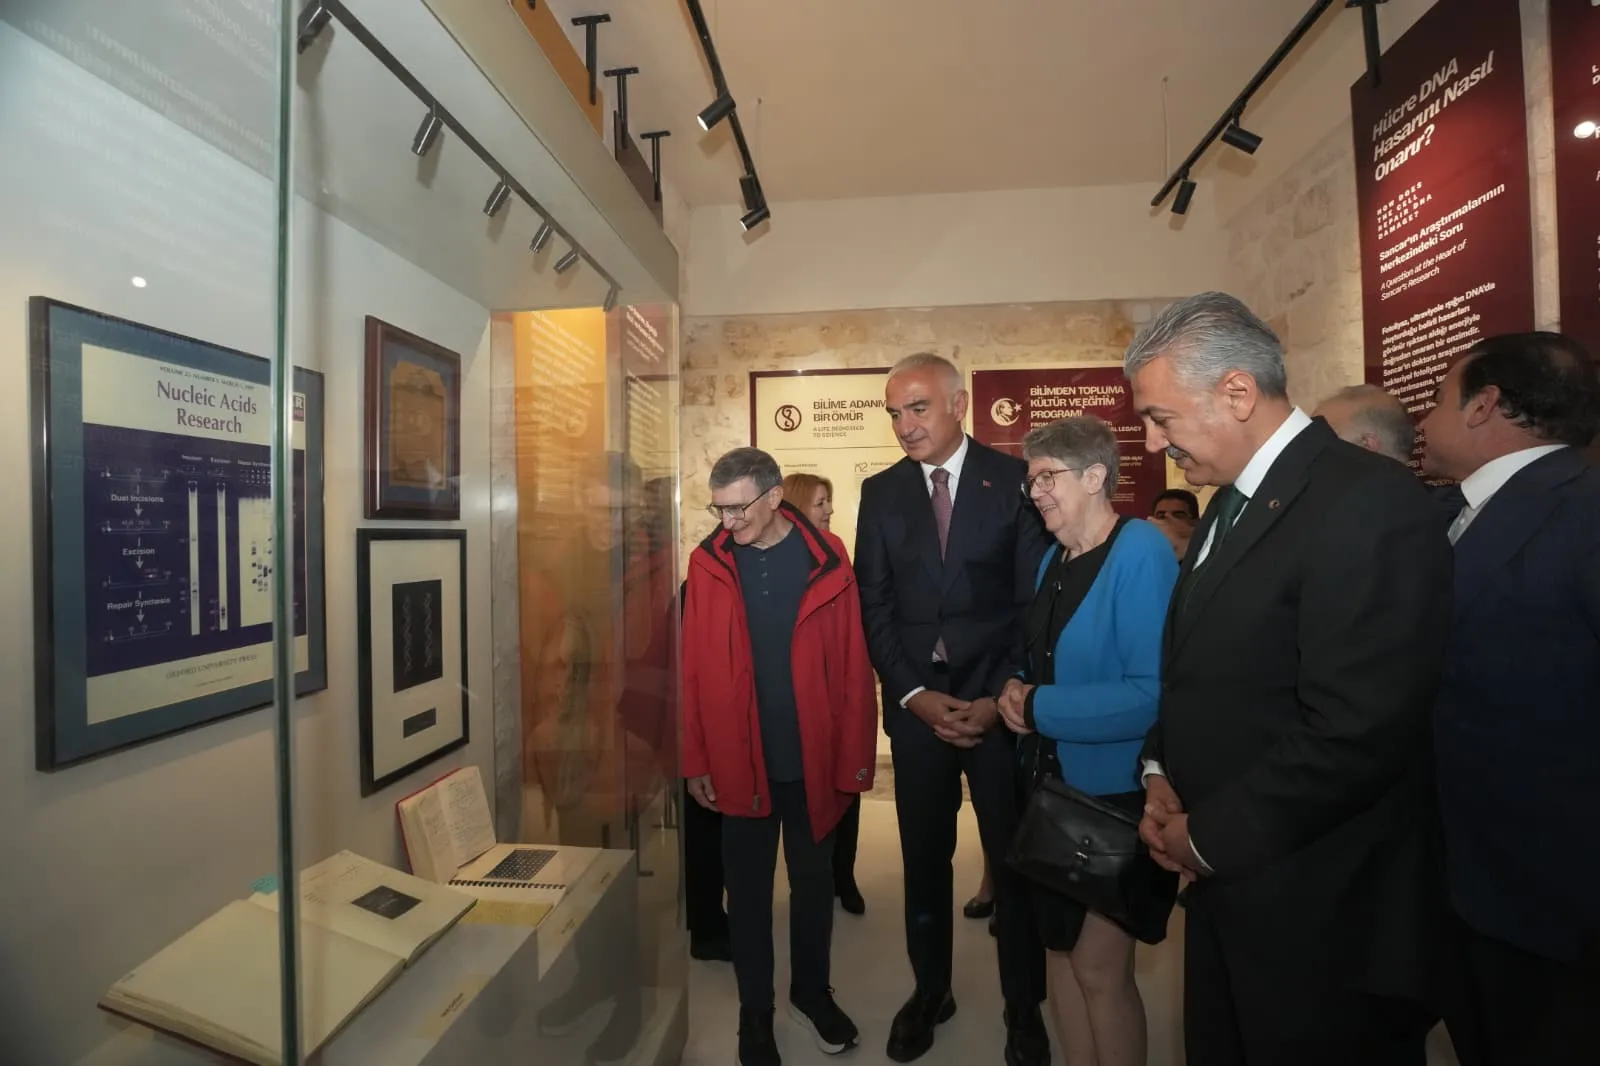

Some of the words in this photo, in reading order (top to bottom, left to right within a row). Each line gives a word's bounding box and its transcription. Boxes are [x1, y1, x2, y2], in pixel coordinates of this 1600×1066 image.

[1372, 94, 1418, 142] Hücre
[1419, 57, 1458, 103] DNA
[1374, 98, 1441, 162] Hasarını
[1443, 50, 1495, 108] Nasıl
[1375, 123, 1435, 181] Onarır?
[1377, 199, 1395, 215] HOW
[1398, 181, 1422, 201] DOES
[1377, 209, 1393, 223] THE
[1396, 194, 1418, 211] CELL
[1377, 209, 1409, 232] REPAIR
[1413, 193, 1432, 210] DNA
[1378, 210, 1419, 240] DAMAGE?
[1379, 233, 1419, 261] Sancar'ın
[1419, 183, 1505, 238] Araştırmalarının
[1380, 234, 1438, 274] Merkezindeki
[1439, 222, 1464, 241] Soru
[1386, 267, 1413, 288] Question
[1414, 263, 1422, 274] at
[1422, 257, 1434, 269] the
[1435, 246, 1457, 264] Heart
[1457, 239, 1468, 252] of
[1408, 266, 1440, 287] Research
[157, 380, 216, 407] Nucleic
[219, 393, 257, 415] Acids
[813, 398, 847, 410] BİLİME
[1030, 385, 1076, 396] BİLİMDEN
[1078, 386, 1125, 395] TOPLUMA
[1030, 396, 1067, 407] KÜLTÜR
[1068, 398, 1081, 407] VE
[1082, 395, 1116, 406] EĞİTİM
[176, 407, 243, 433] Research
[813, 410, 830, 422] BİR
[832, 409, 864, 421] ÖMÜR
[1030, 409, 1082, 419] PROGRAMI
[1118, 426, 1142, 434] LEGACY
[111, 494, 129, 502] Dual
[130, 494, 164, 503] Incisions
[122, 547, 155, 556] Excision
[107, 601, 133, 611] Repair
